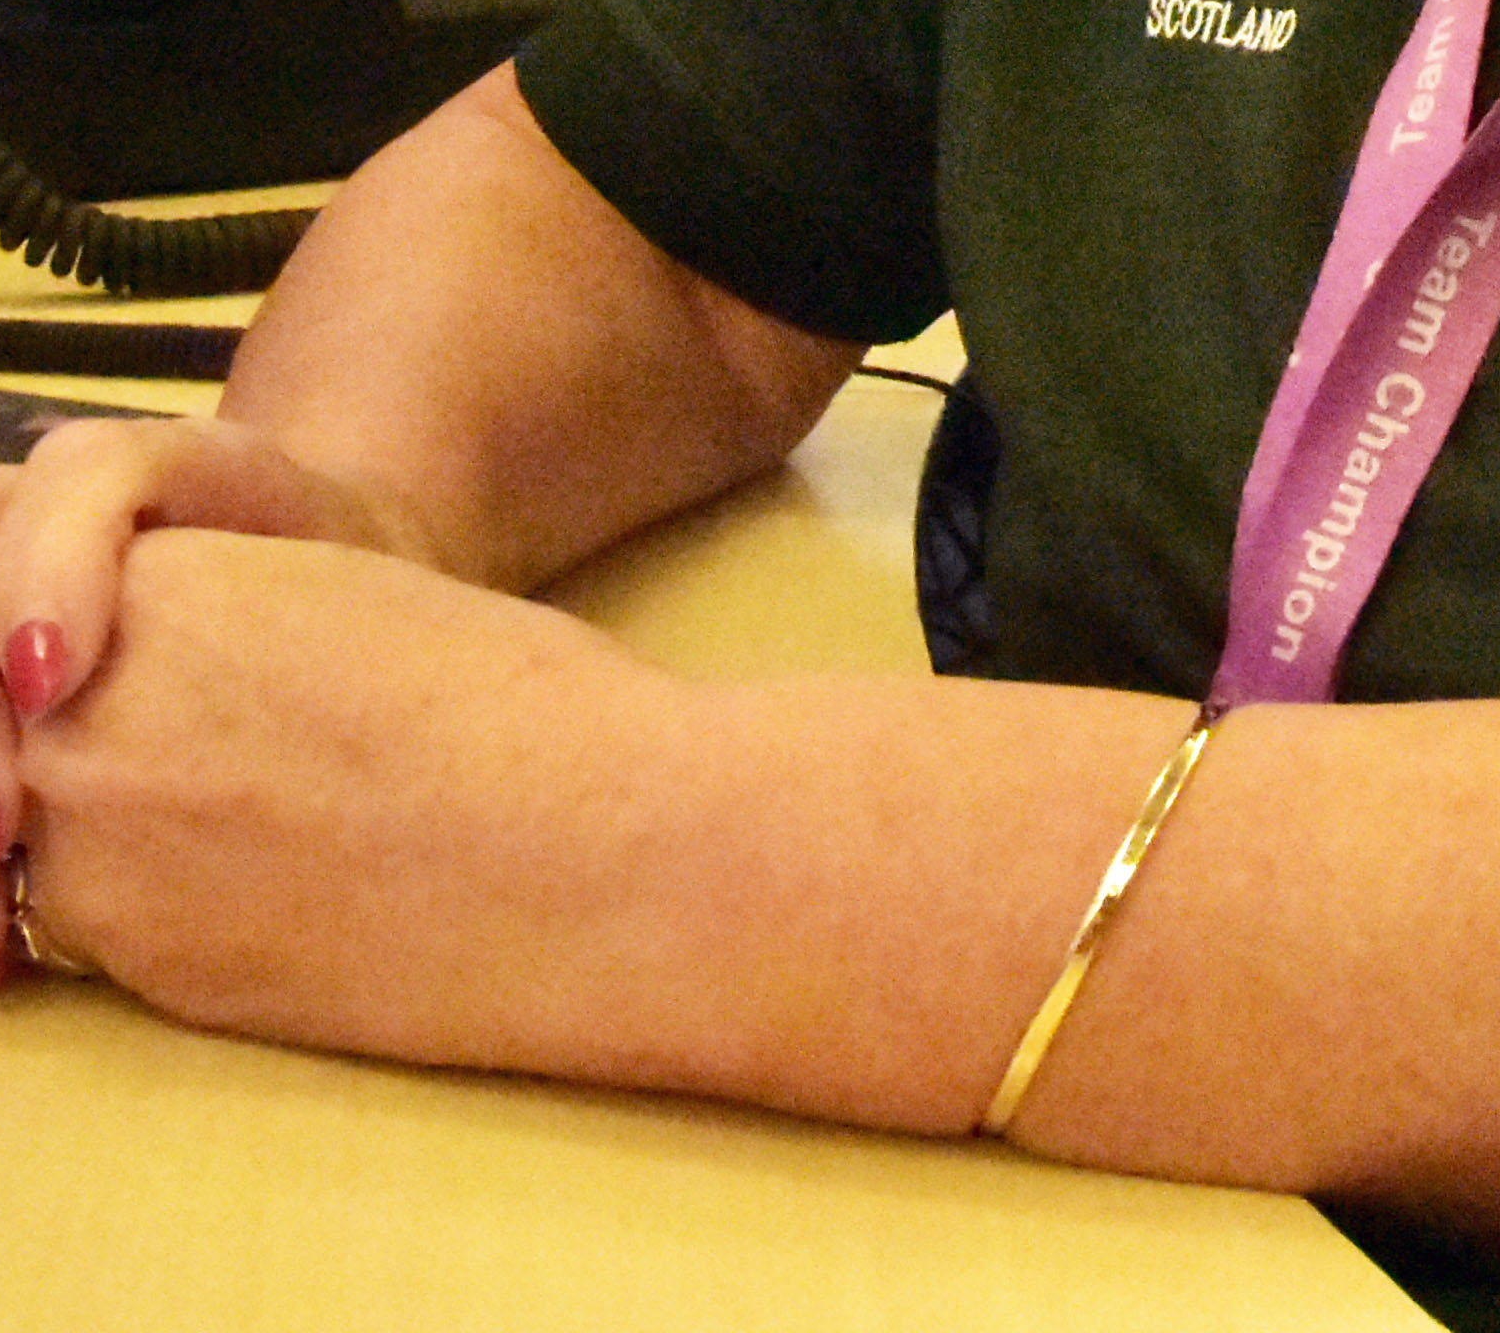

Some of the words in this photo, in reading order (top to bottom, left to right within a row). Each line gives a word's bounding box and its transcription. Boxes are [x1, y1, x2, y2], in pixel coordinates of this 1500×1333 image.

[1388, 13, 1455, 155] Team
[1397, 210, 1499, 356] Team
[1270, 371, 1426, 664] Champion
